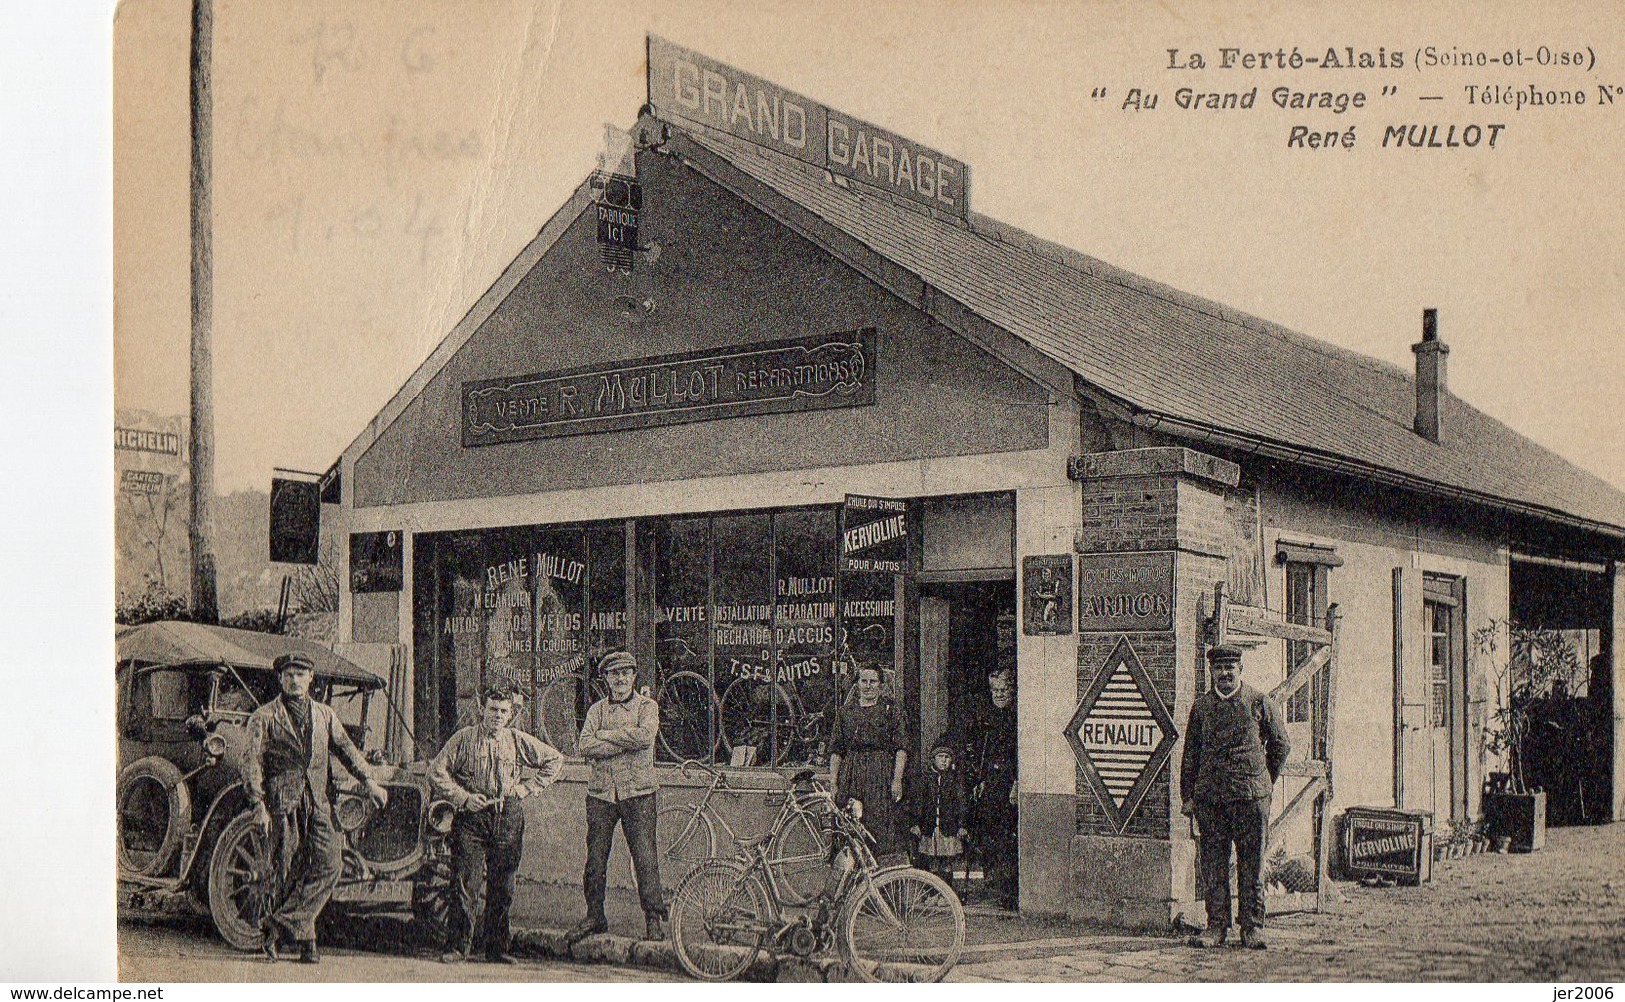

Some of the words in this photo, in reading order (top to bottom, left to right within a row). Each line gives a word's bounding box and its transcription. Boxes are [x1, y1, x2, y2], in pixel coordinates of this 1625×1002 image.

[673, 58, 807, 148] GRAND
[828, 120, 955, 205] GARAGE
[495, 396, 548, 419] VENTE
[559, 384, 586, 416] R.
[598, 365, 725, 410] MULLOT
[844, 515, 907, 553] KERVOLINE
[536, 552, 585, 584] MULLOT
[848, 559, 869, 570] POUR
[873, 560, 900, 571] AUTOS
[666, 606, 706, 622] VENTE
[714, 603, 771, 621] INSTALLATION
[1083, 592, 1170, 619] ARMOR
[444, 615, 478, 634] AUTOS
[776, 626, 833, 645] D'ACCUS
[776, 657, 820, 682] AUTOS
[1083, 723, 1157, 746] RENAULT
[1354, 834, 1415, 858] KERVOLINE
